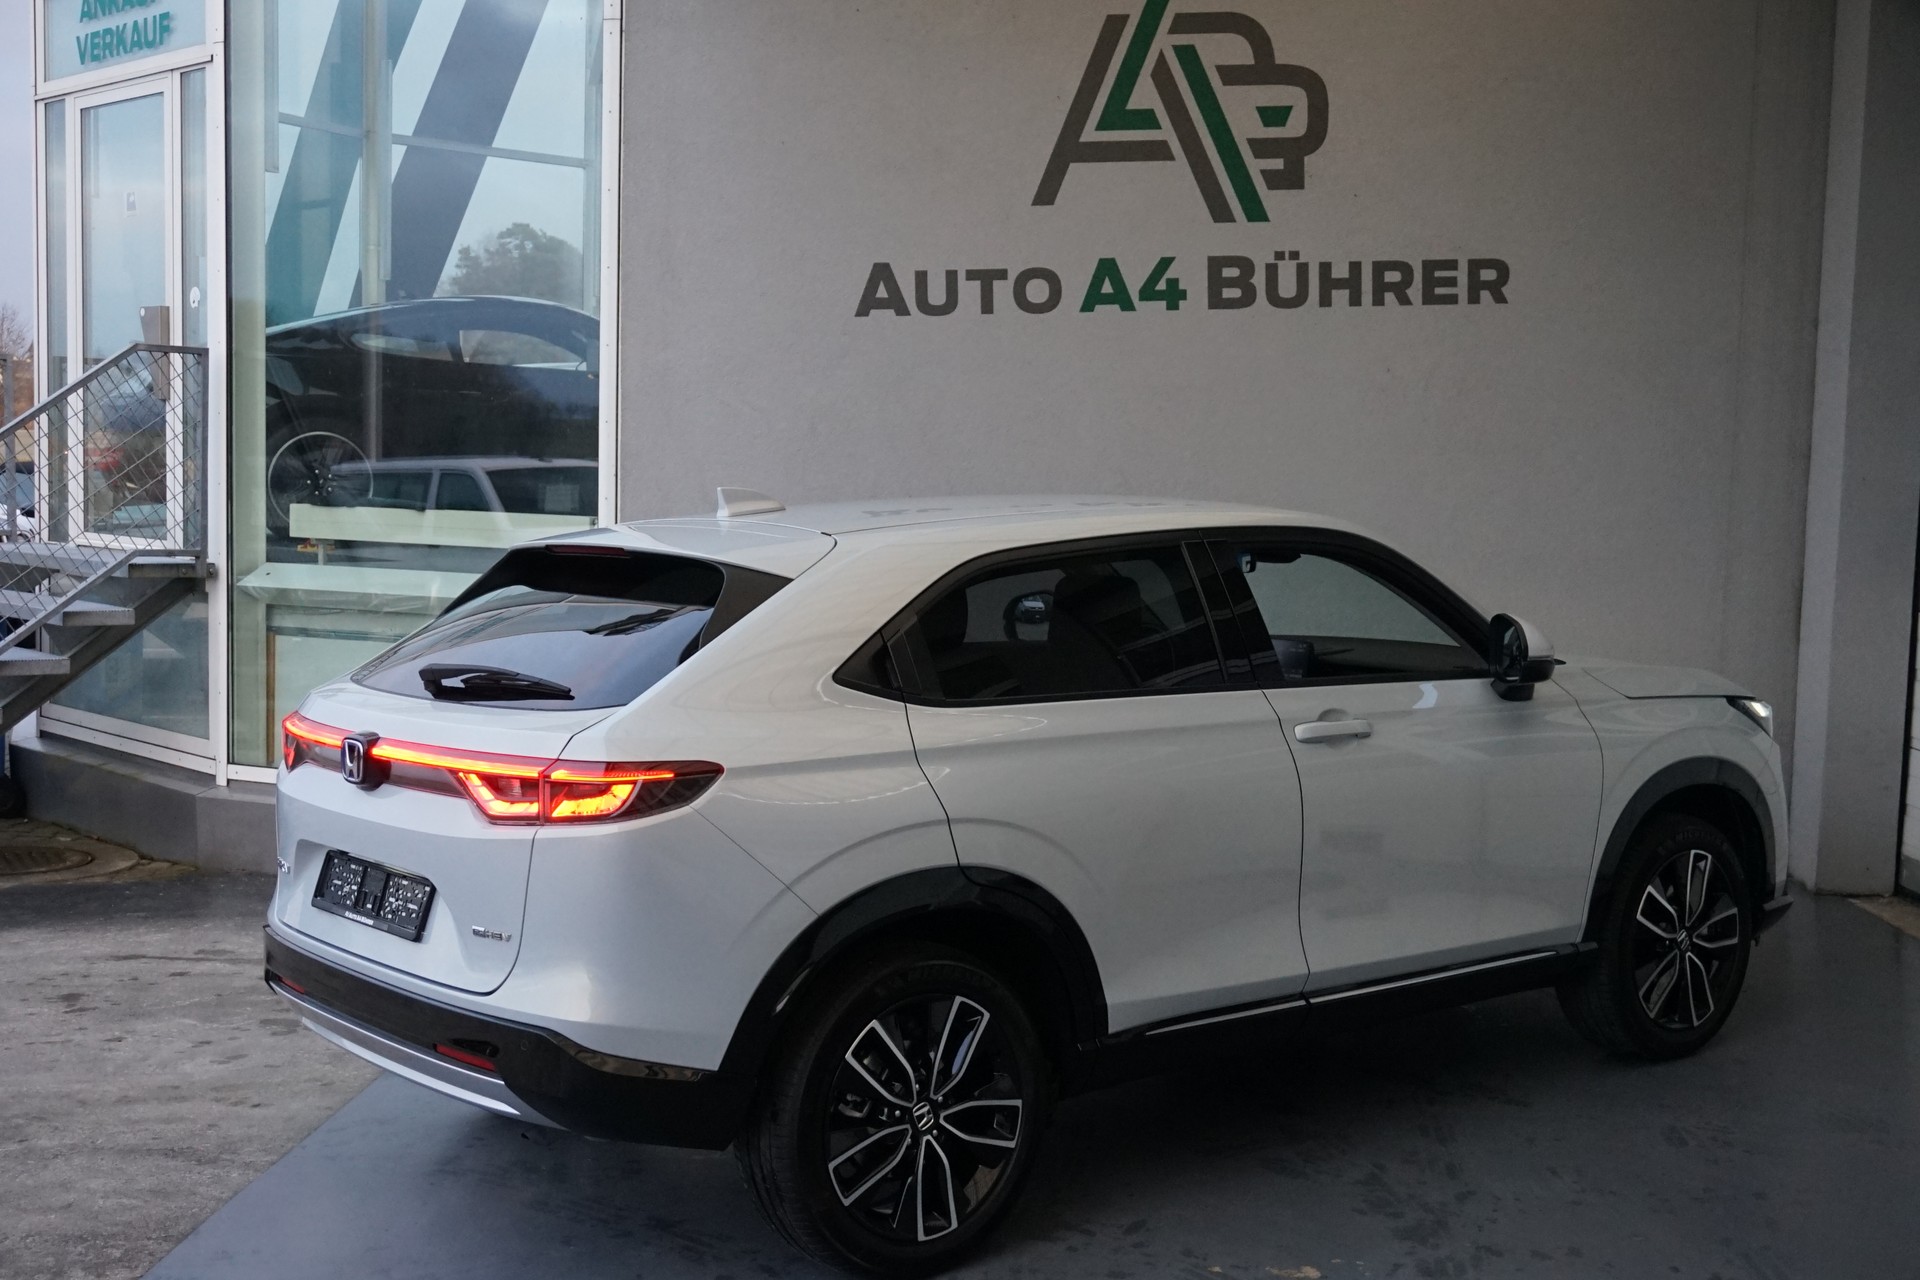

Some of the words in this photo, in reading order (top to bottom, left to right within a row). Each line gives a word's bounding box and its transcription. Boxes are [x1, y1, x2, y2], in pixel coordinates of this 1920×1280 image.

[76, 11, 170, 65] VERKAUF
[855, 262, 1063, 317] AUTO
[1080, 256, 1188, 312] A4
[1207, 251, 1511, 309] BÜHRER
